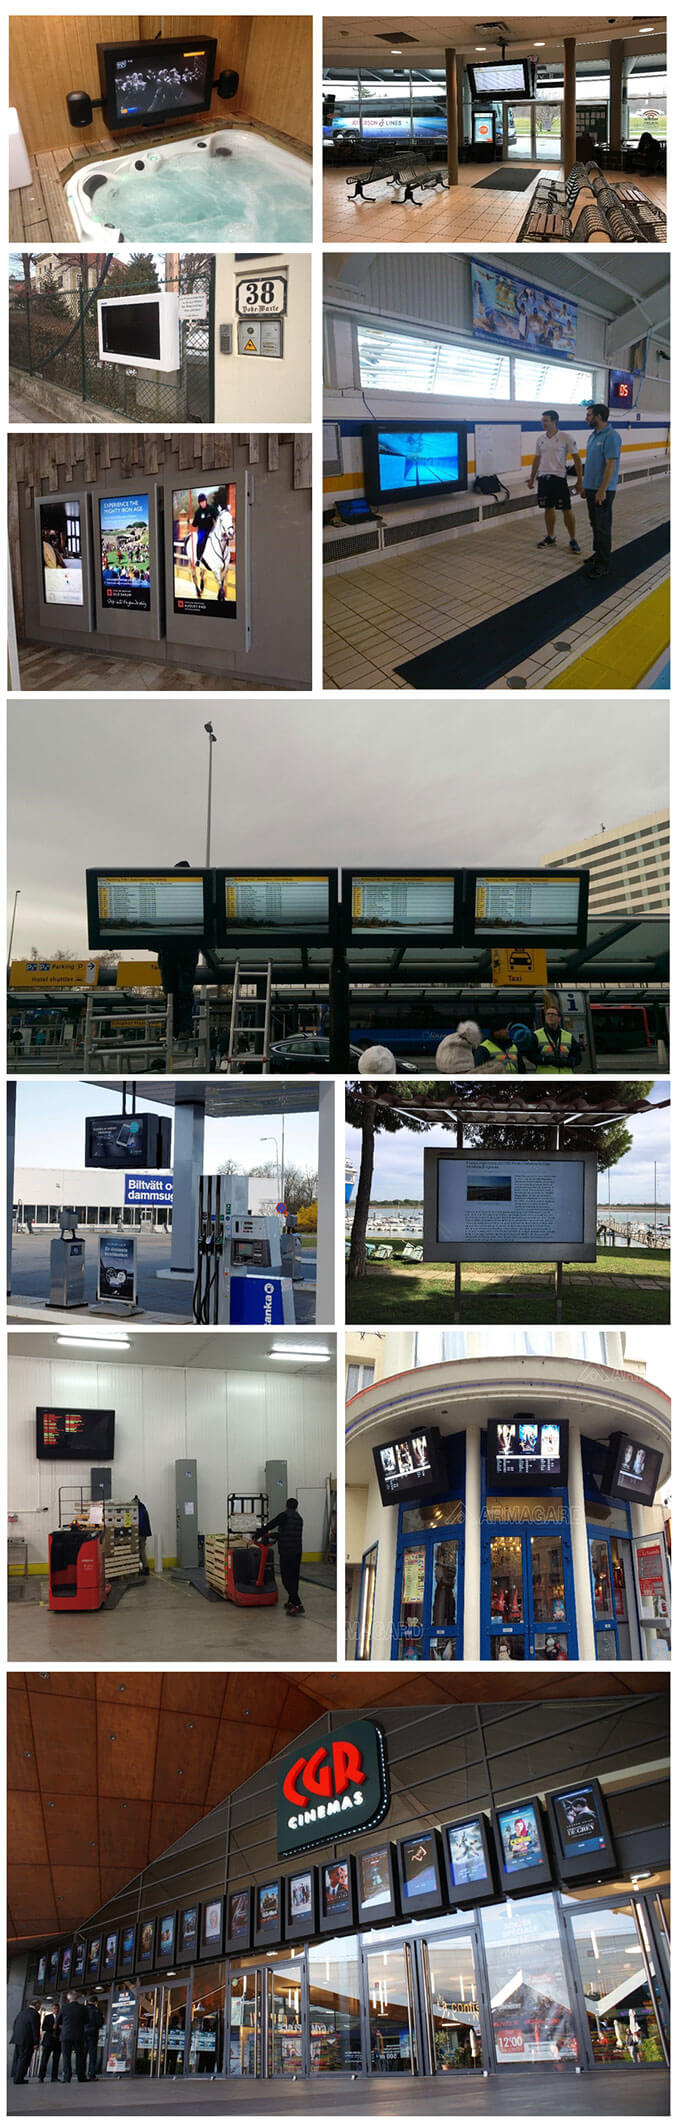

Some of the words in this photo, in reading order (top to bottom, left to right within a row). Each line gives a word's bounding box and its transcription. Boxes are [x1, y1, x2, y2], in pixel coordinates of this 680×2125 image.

[246, 281, 275, 305] 38
[128, 1179, 164, 1191] Biltvätt
[282, 1741, 367, 1808] CGR
[287, 1791, 364, 1830] CINEMAS
